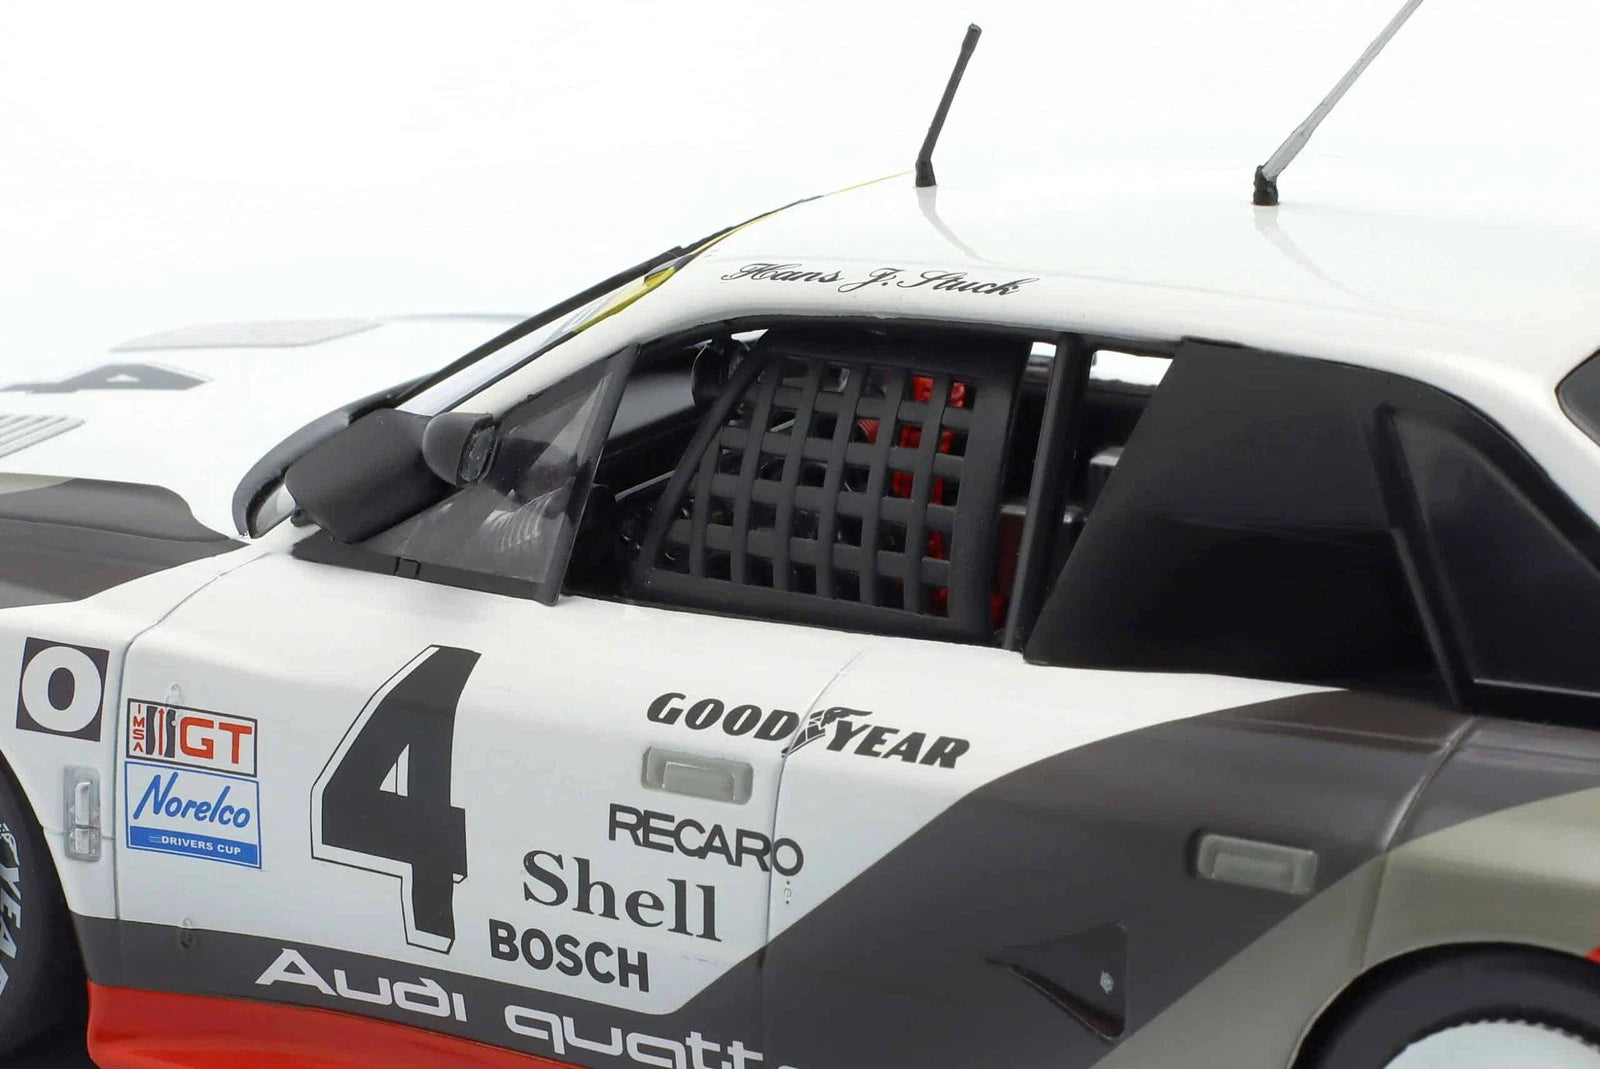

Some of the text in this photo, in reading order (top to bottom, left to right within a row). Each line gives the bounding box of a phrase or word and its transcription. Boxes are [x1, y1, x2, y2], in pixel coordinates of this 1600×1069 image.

[721, 262, 1040, 297] Hans J. Stuck
[132, 703, 146, 753] IMSA
[180, 716, 253, 765] GT
[133, 771, 251, 828] Norelco
[311, 644, 482, 955] 4
[161, 835, 242, 856] DRIVERS CUP
[608, 803, 805, 877] RECARO
[523, 848, 723, 943] Shell
[255, 947, 468, 1023] Audi
[489, 917, 650, 993] BOSCH
